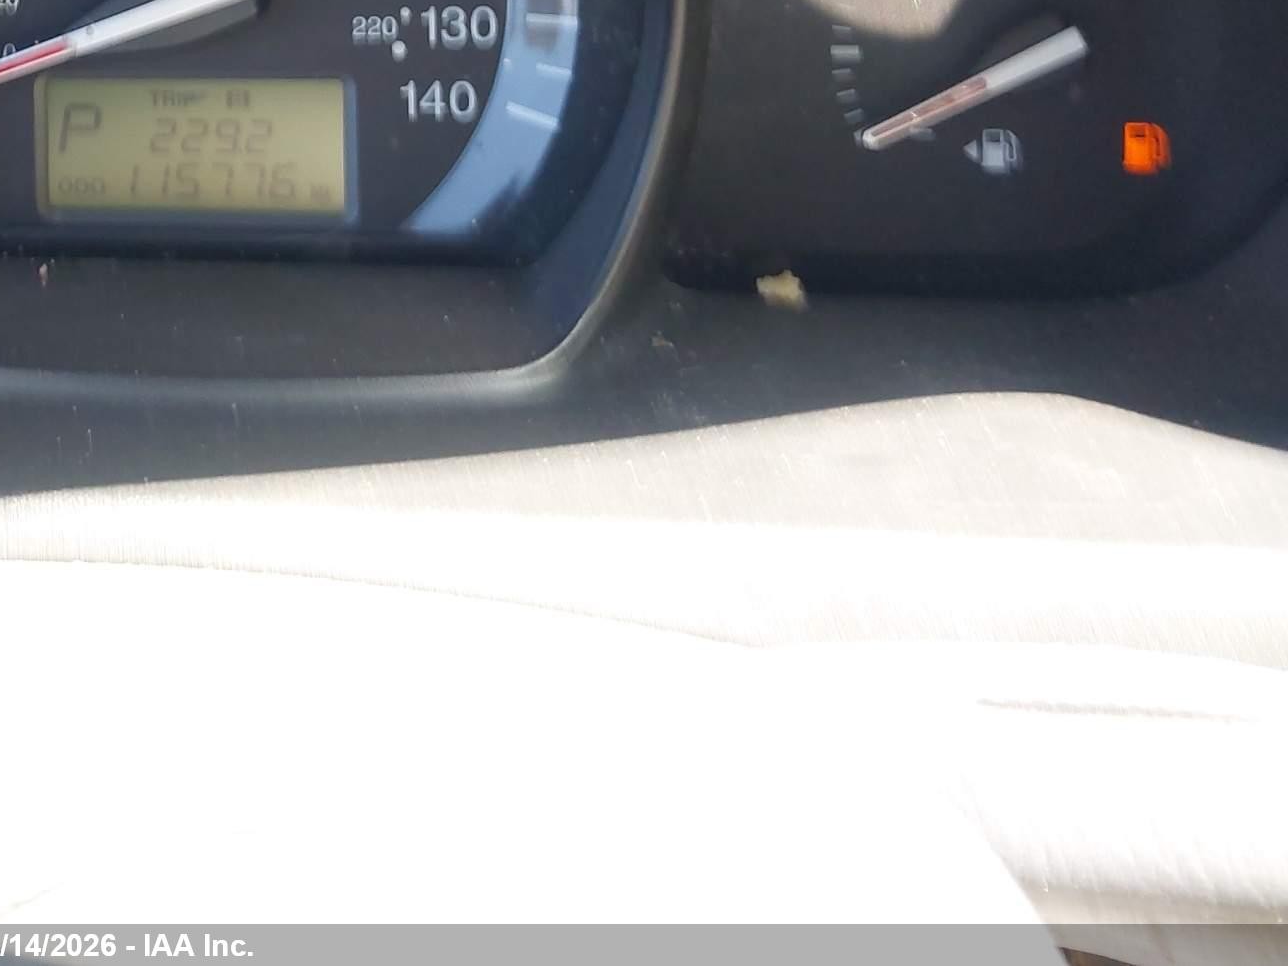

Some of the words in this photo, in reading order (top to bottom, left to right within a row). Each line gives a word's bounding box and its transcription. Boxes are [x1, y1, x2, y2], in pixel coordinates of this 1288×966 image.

[352, 16, 399, 45] 220
[420, 5, 499, 49] 130
[400, 80, 478, 122] 140
[60, 103, 102, 153] P
[130, 162, 296, 201] 115776
